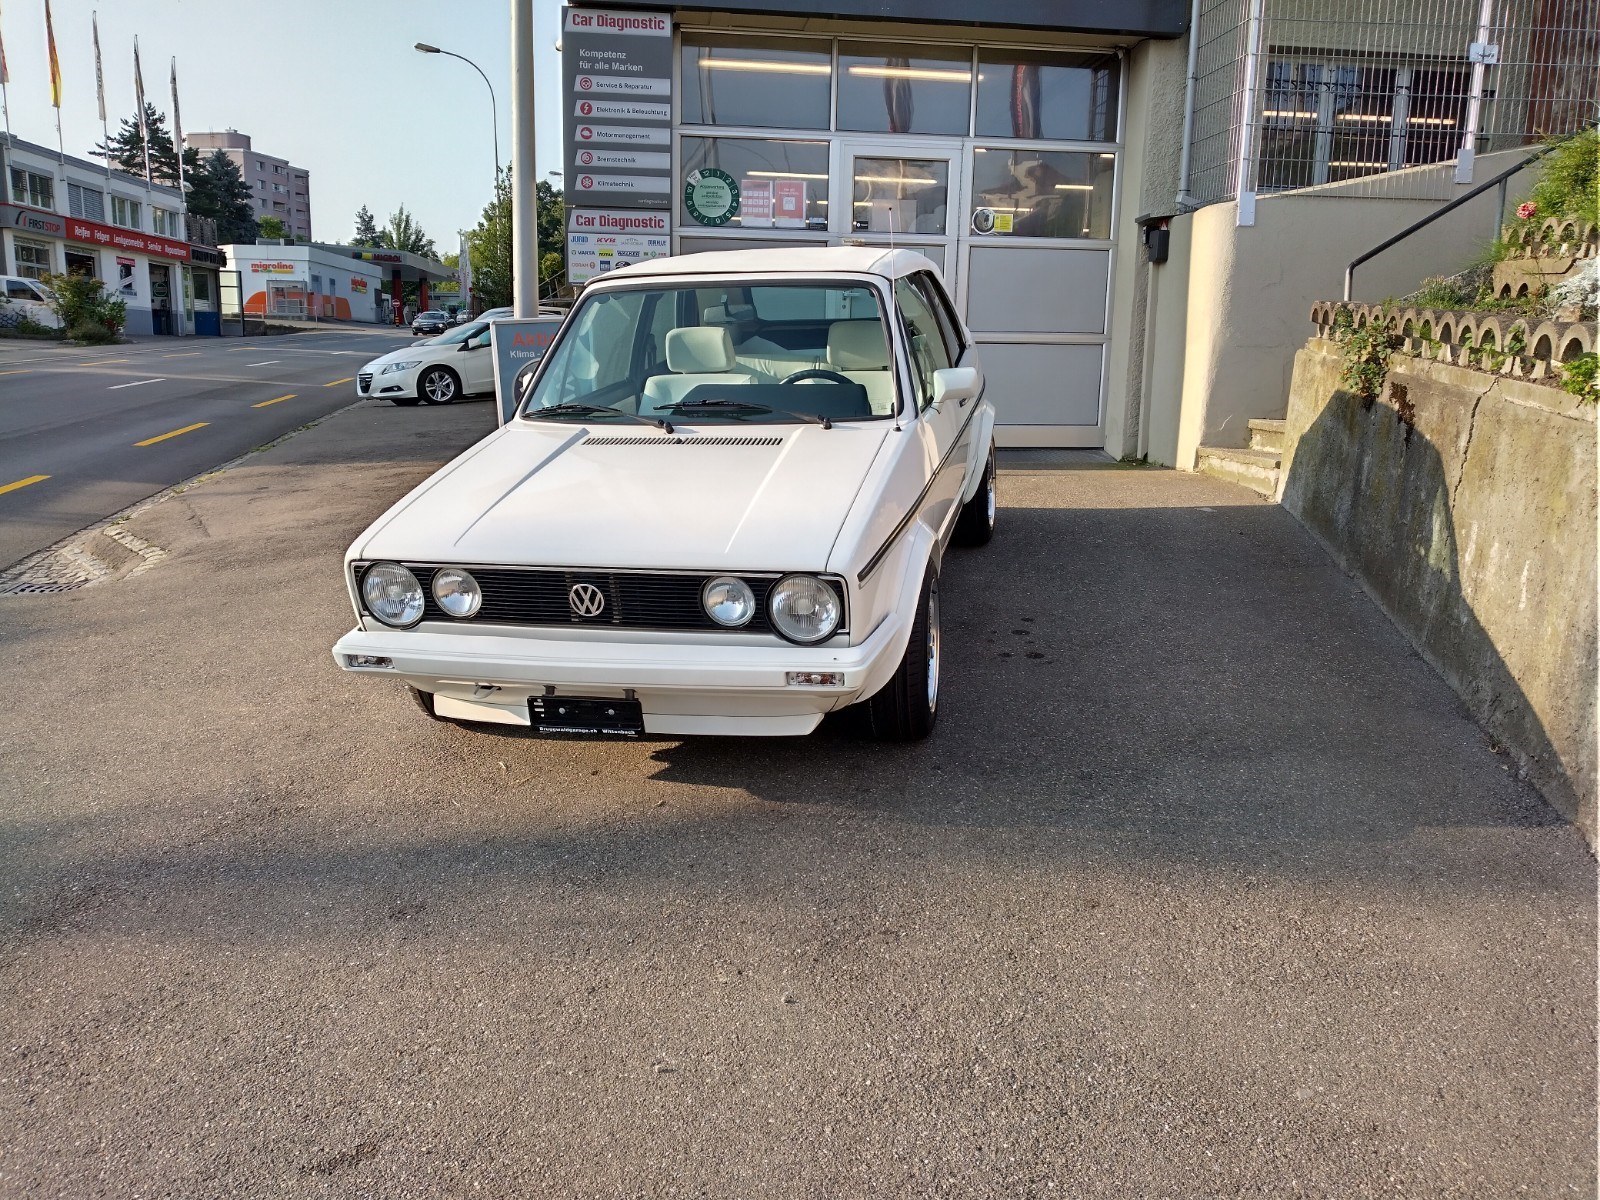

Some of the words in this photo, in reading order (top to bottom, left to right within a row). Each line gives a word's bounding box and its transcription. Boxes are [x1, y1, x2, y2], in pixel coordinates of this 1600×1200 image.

[572, 13, 593, 26] Car
[596, 14, 665, 31] Diagnostic
[579, 48, 627, 59] Kompetenz
[579, 60, 591, 69] für
[594, 61, 609, 70] alle
[611, 62, 643, 71] Marken
[596, 81, 617, 89] Service
[624, 82, 652, 90] Reparatur
[596, 106, 625, 114] Elektronik
[631, 108, 667, 116] Beleuchtung
[596, 131, 650, 140] Motormanagement
[596, 156, 636, 164] Bremstechnik
[597, 180, 635, 189] Klimatechnik
[28, 218, 61, 233] FIRSTSTOP
[575, 213, 597, 227] Car
[599, 214, 665, 231] Diagnostic
[74, 225, 91, 239] Reifen
[94, 230, 110, 243] Felgen
[113, 234, 145, 249] Lenkgeometrie
[373, 253, 402, 263] MIGROL
[250, 261, 294, 271] migrolino
[509, 350, 536, 359] Klima
